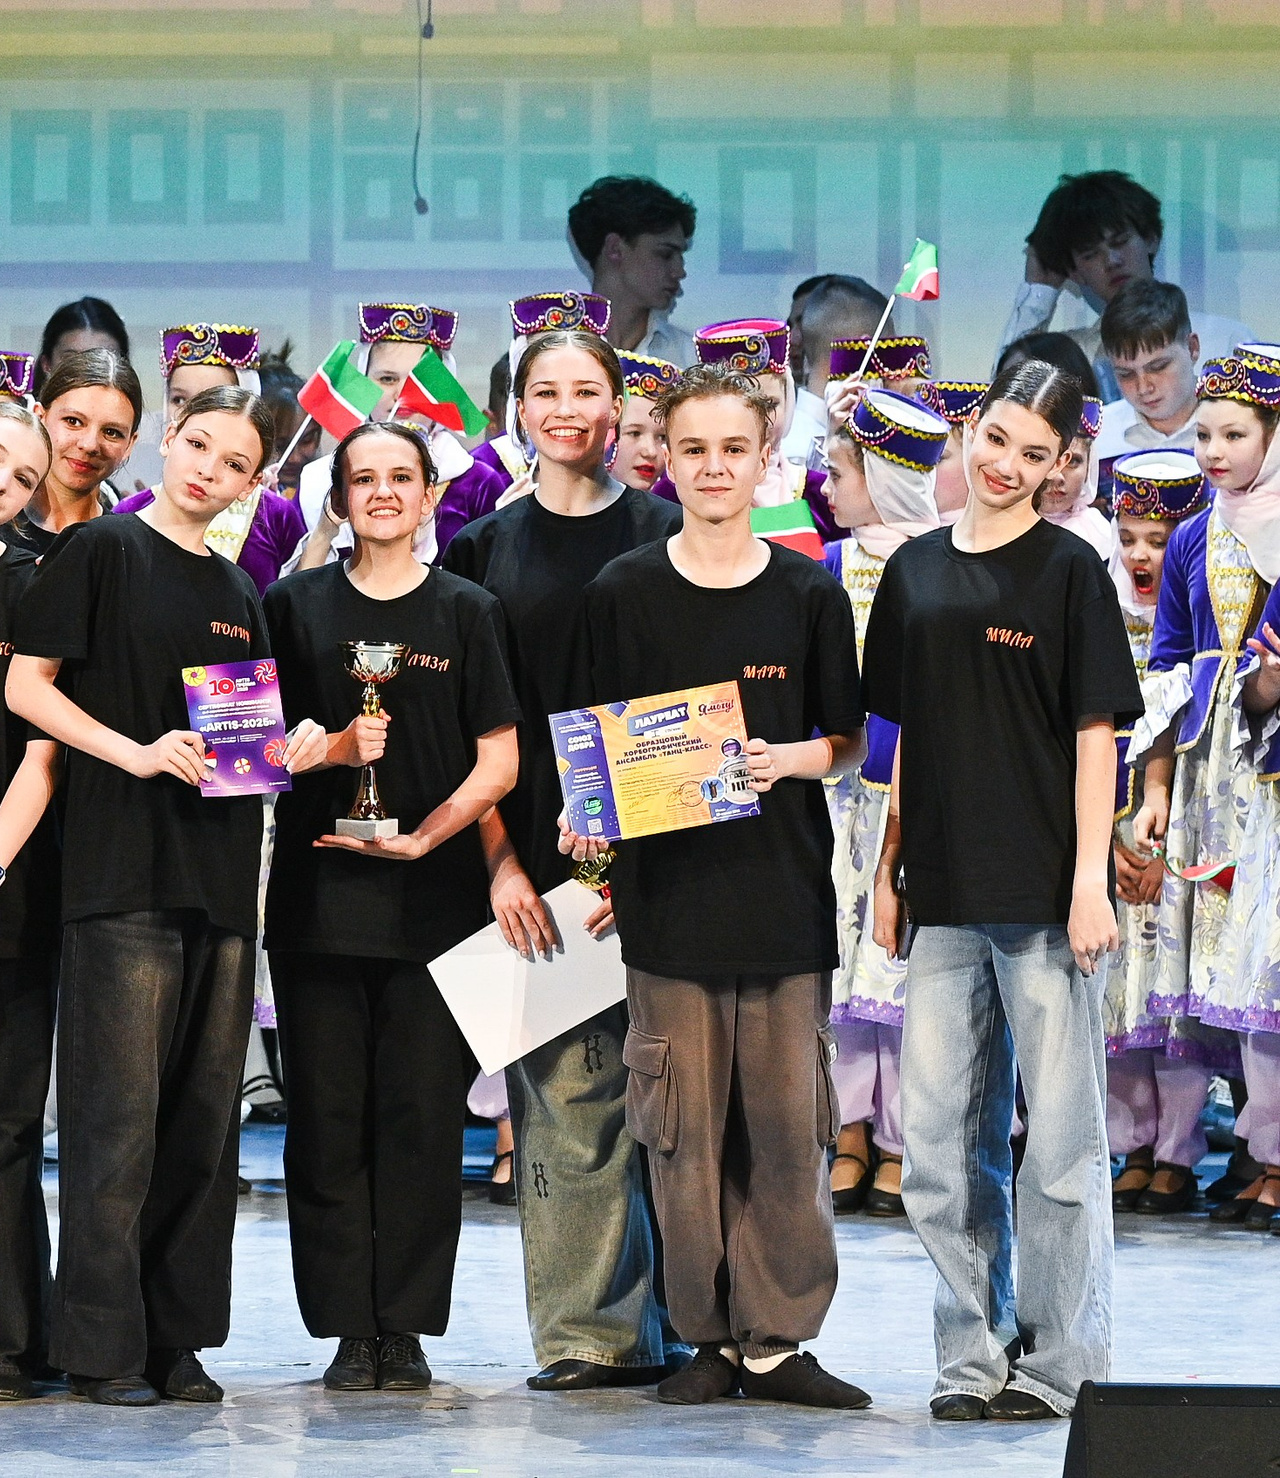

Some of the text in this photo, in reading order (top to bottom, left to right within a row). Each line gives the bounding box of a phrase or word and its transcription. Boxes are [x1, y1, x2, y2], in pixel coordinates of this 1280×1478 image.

[985, 627, 1034, 649] МИЛА
[407, 653, 450, 672] ЛИЗА
[743, 665, 787, 680] МАРК
[634, 706, 687, 729] ЛАУРЕАТ
[567, 734, 593, 744] СОЮЗ
[623, 736, 702, 757] ХОРЕОГРАФИЧЕСКИЙ
[636, 732, 687, 748] ОБРАЗЦОВЫЙ
[616, 753, 657, 766] АНСАМБЛЬ
